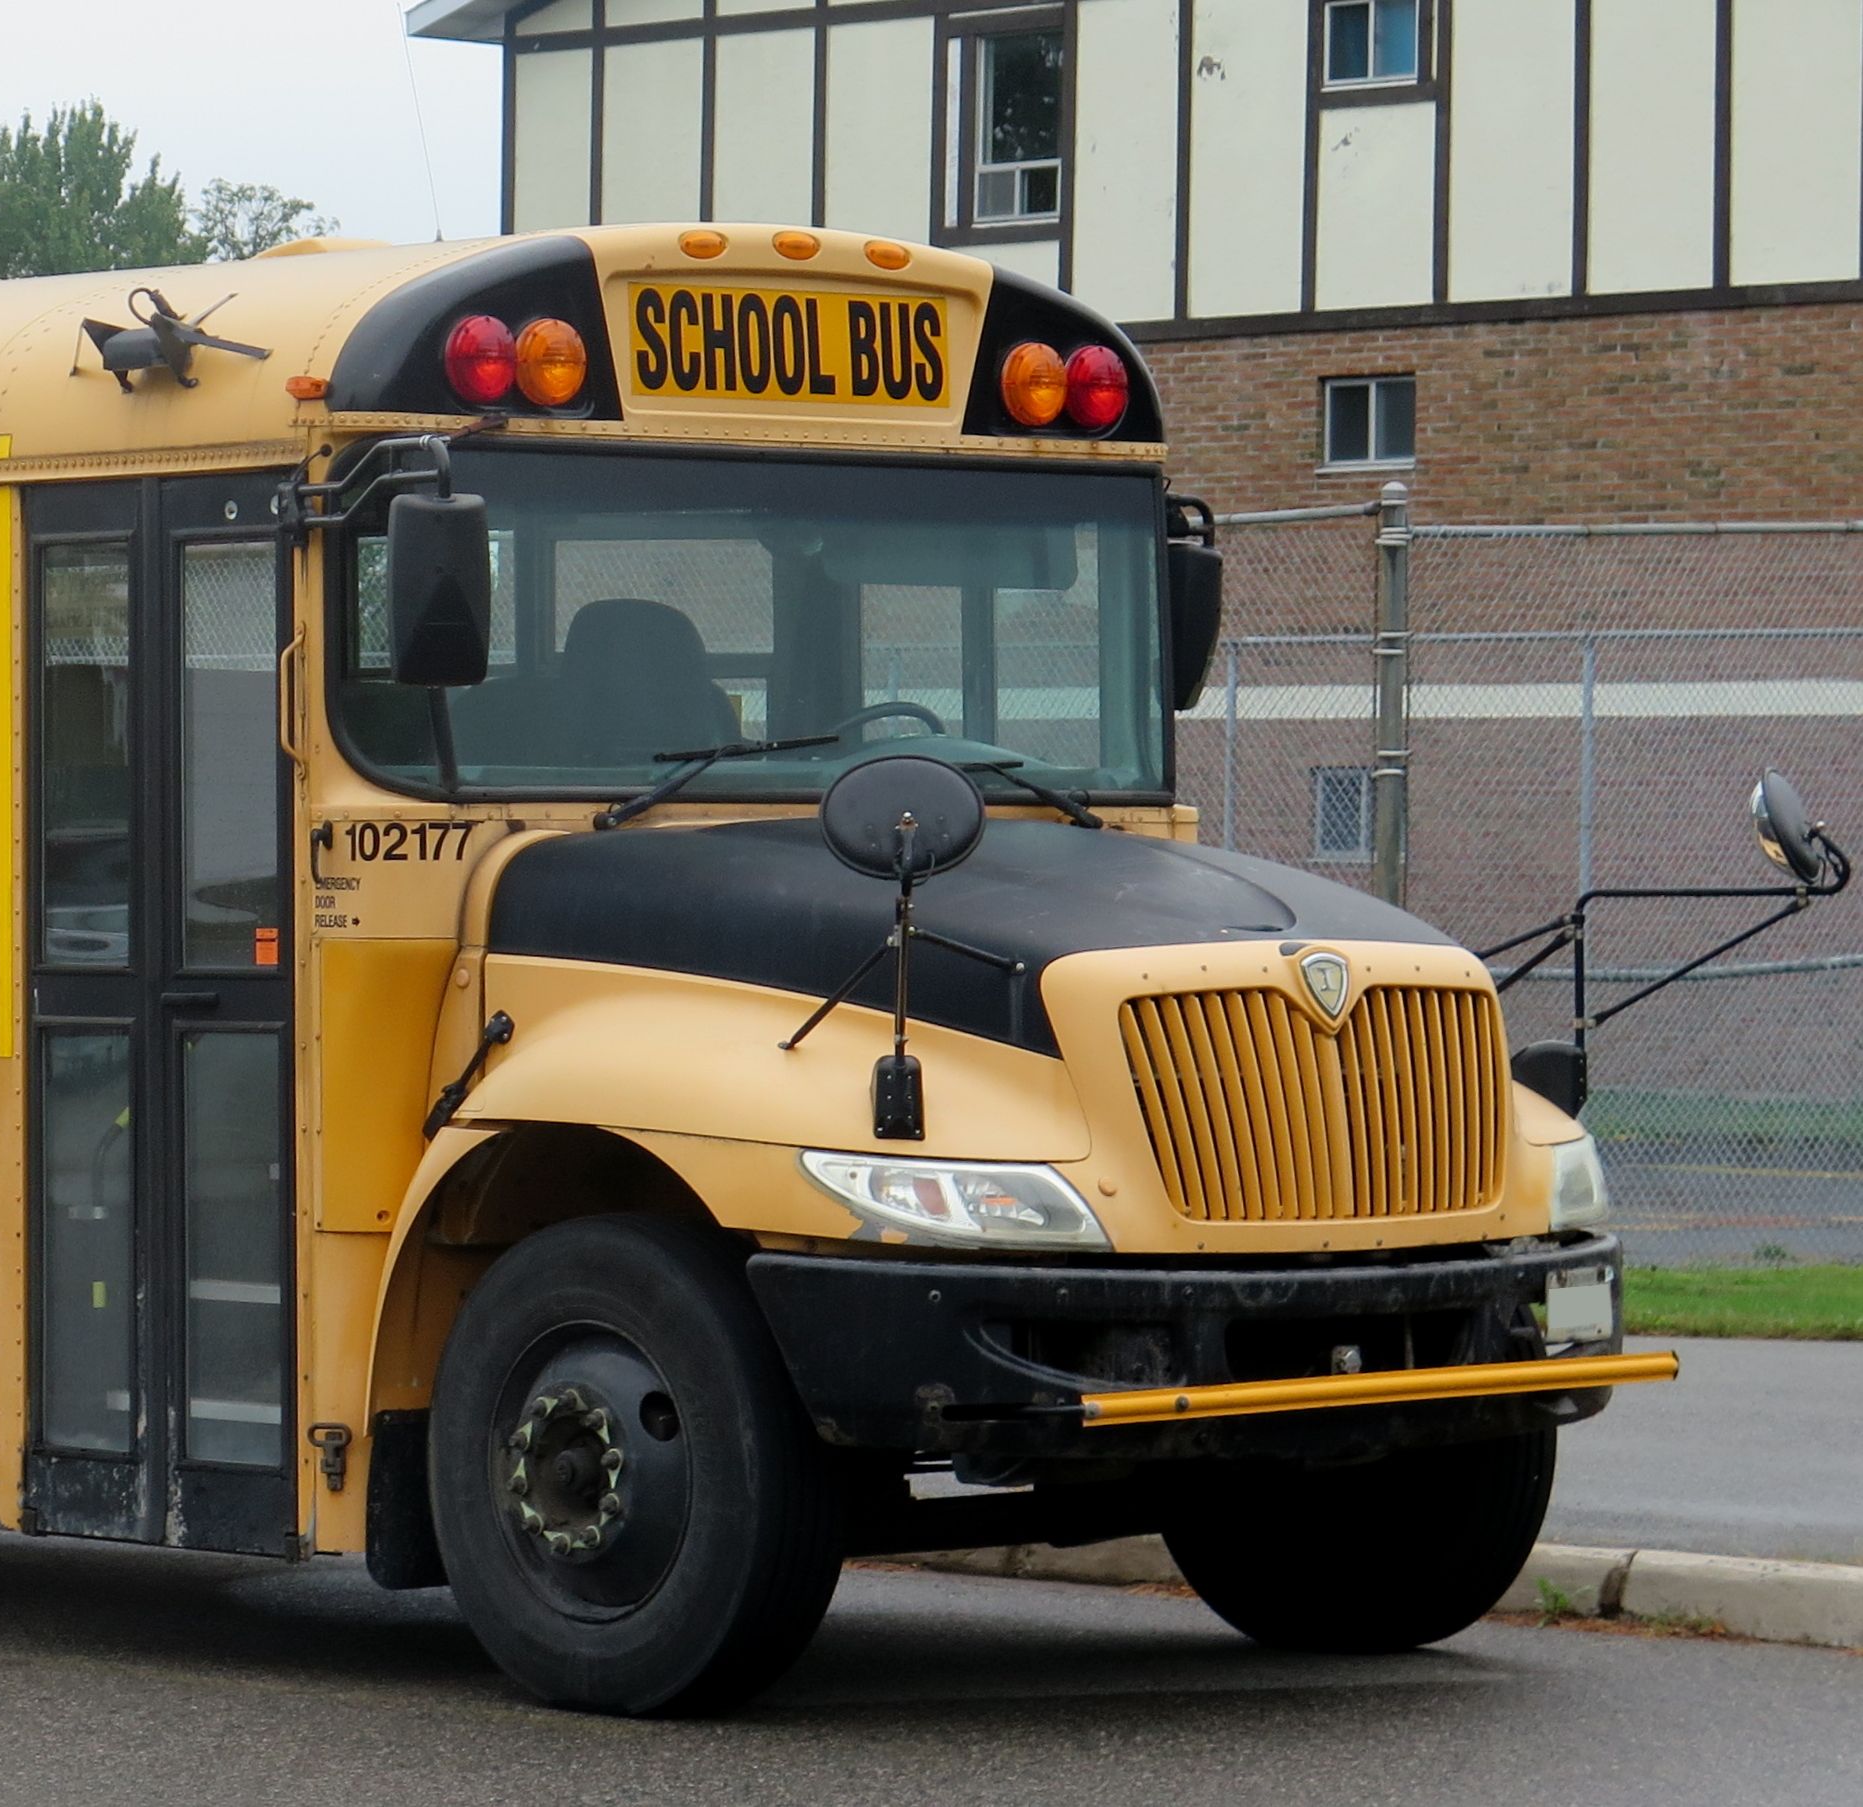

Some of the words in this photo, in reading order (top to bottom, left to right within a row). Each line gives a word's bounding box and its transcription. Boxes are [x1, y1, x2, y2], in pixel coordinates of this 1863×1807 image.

[636, 287, 836, 396] SCHOOL
[848, 300, 944, 401] BUS
[345, 822, 473, 861] 102177
[315, 895, 336, 908] DOOR
[315, 914, 347, 928] RELEASE
